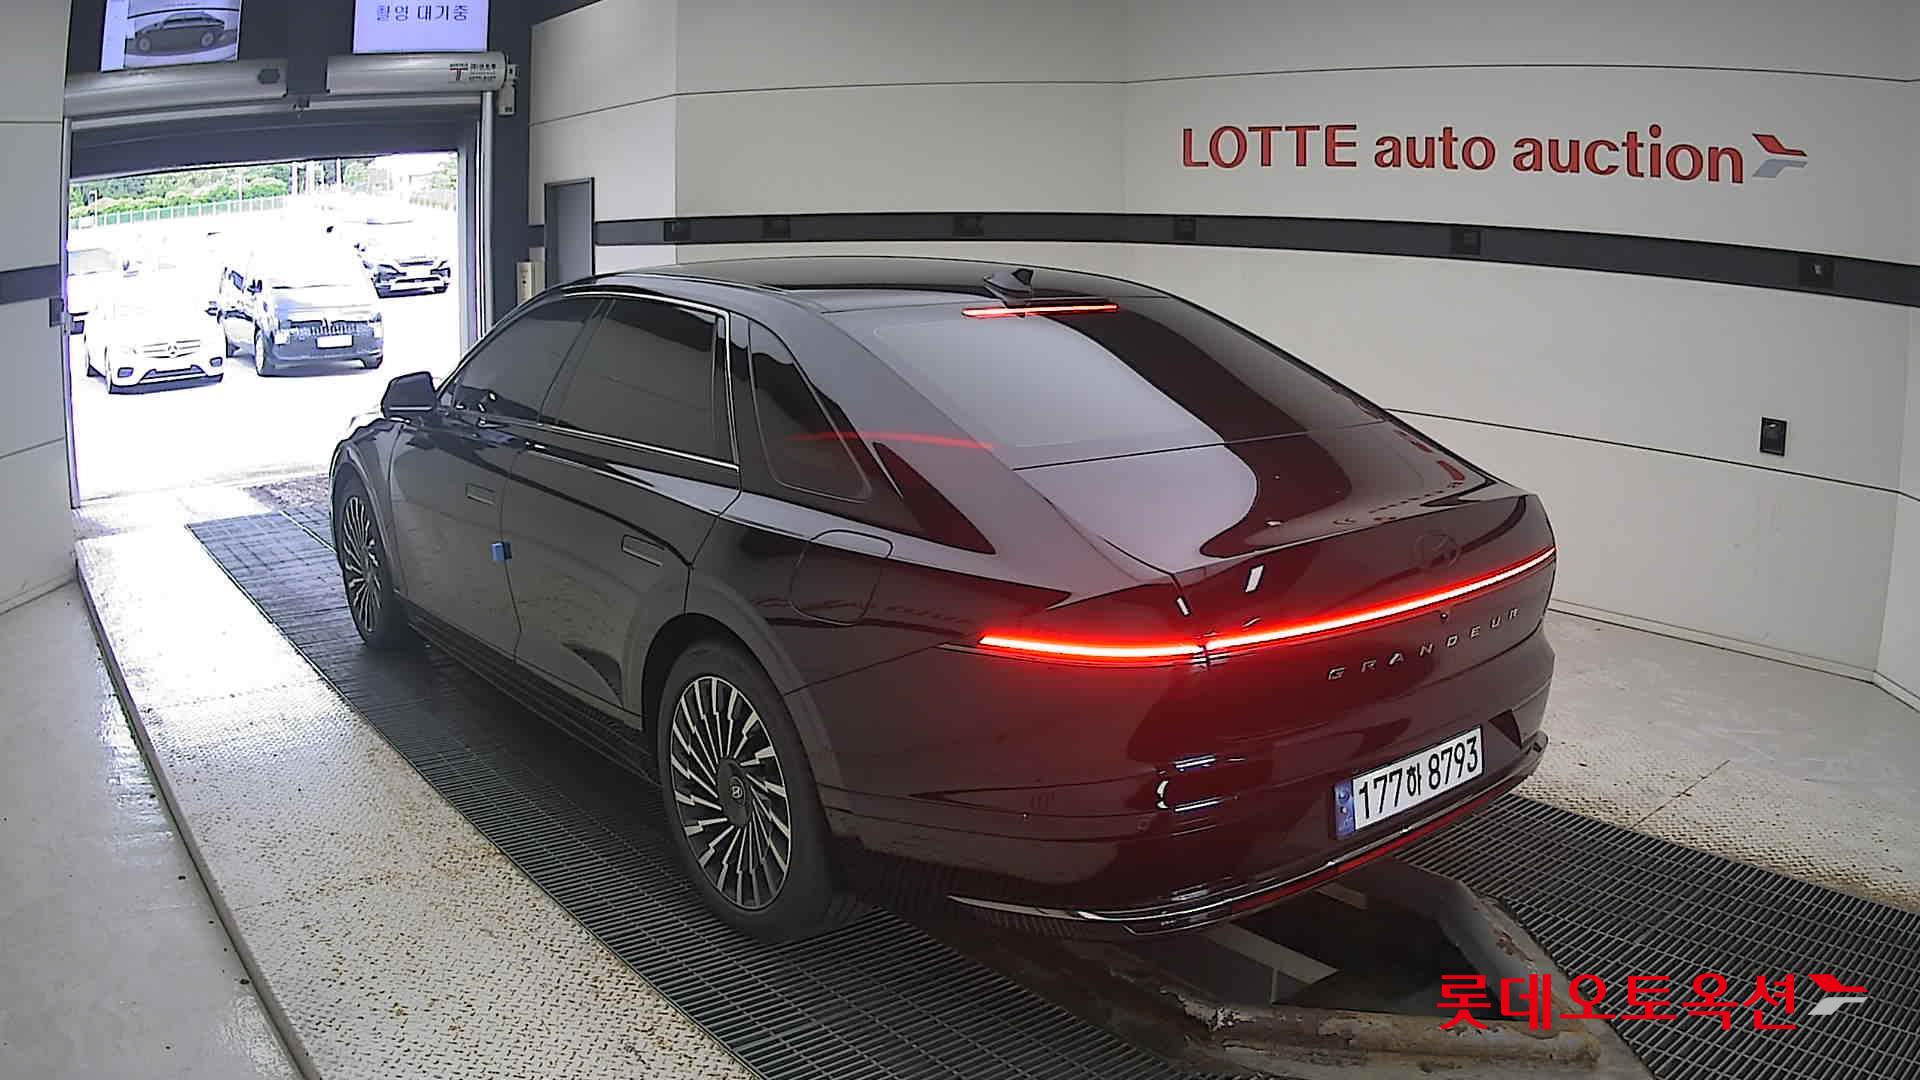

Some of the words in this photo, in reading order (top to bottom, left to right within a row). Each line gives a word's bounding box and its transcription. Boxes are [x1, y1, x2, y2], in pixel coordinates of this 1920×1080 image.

[417, 5, 467, 21] 대기중
[1182, 124, 1357, 168] LOTTE
[1374, 126, 1497, 171] auto
[1512, 124, 1744, 184] auction
[1327, 607, 1520, 681] GRANDEUR
[1358, 762, 1422, 819] 177하
[1427, 735, 1479, 790] 8793
